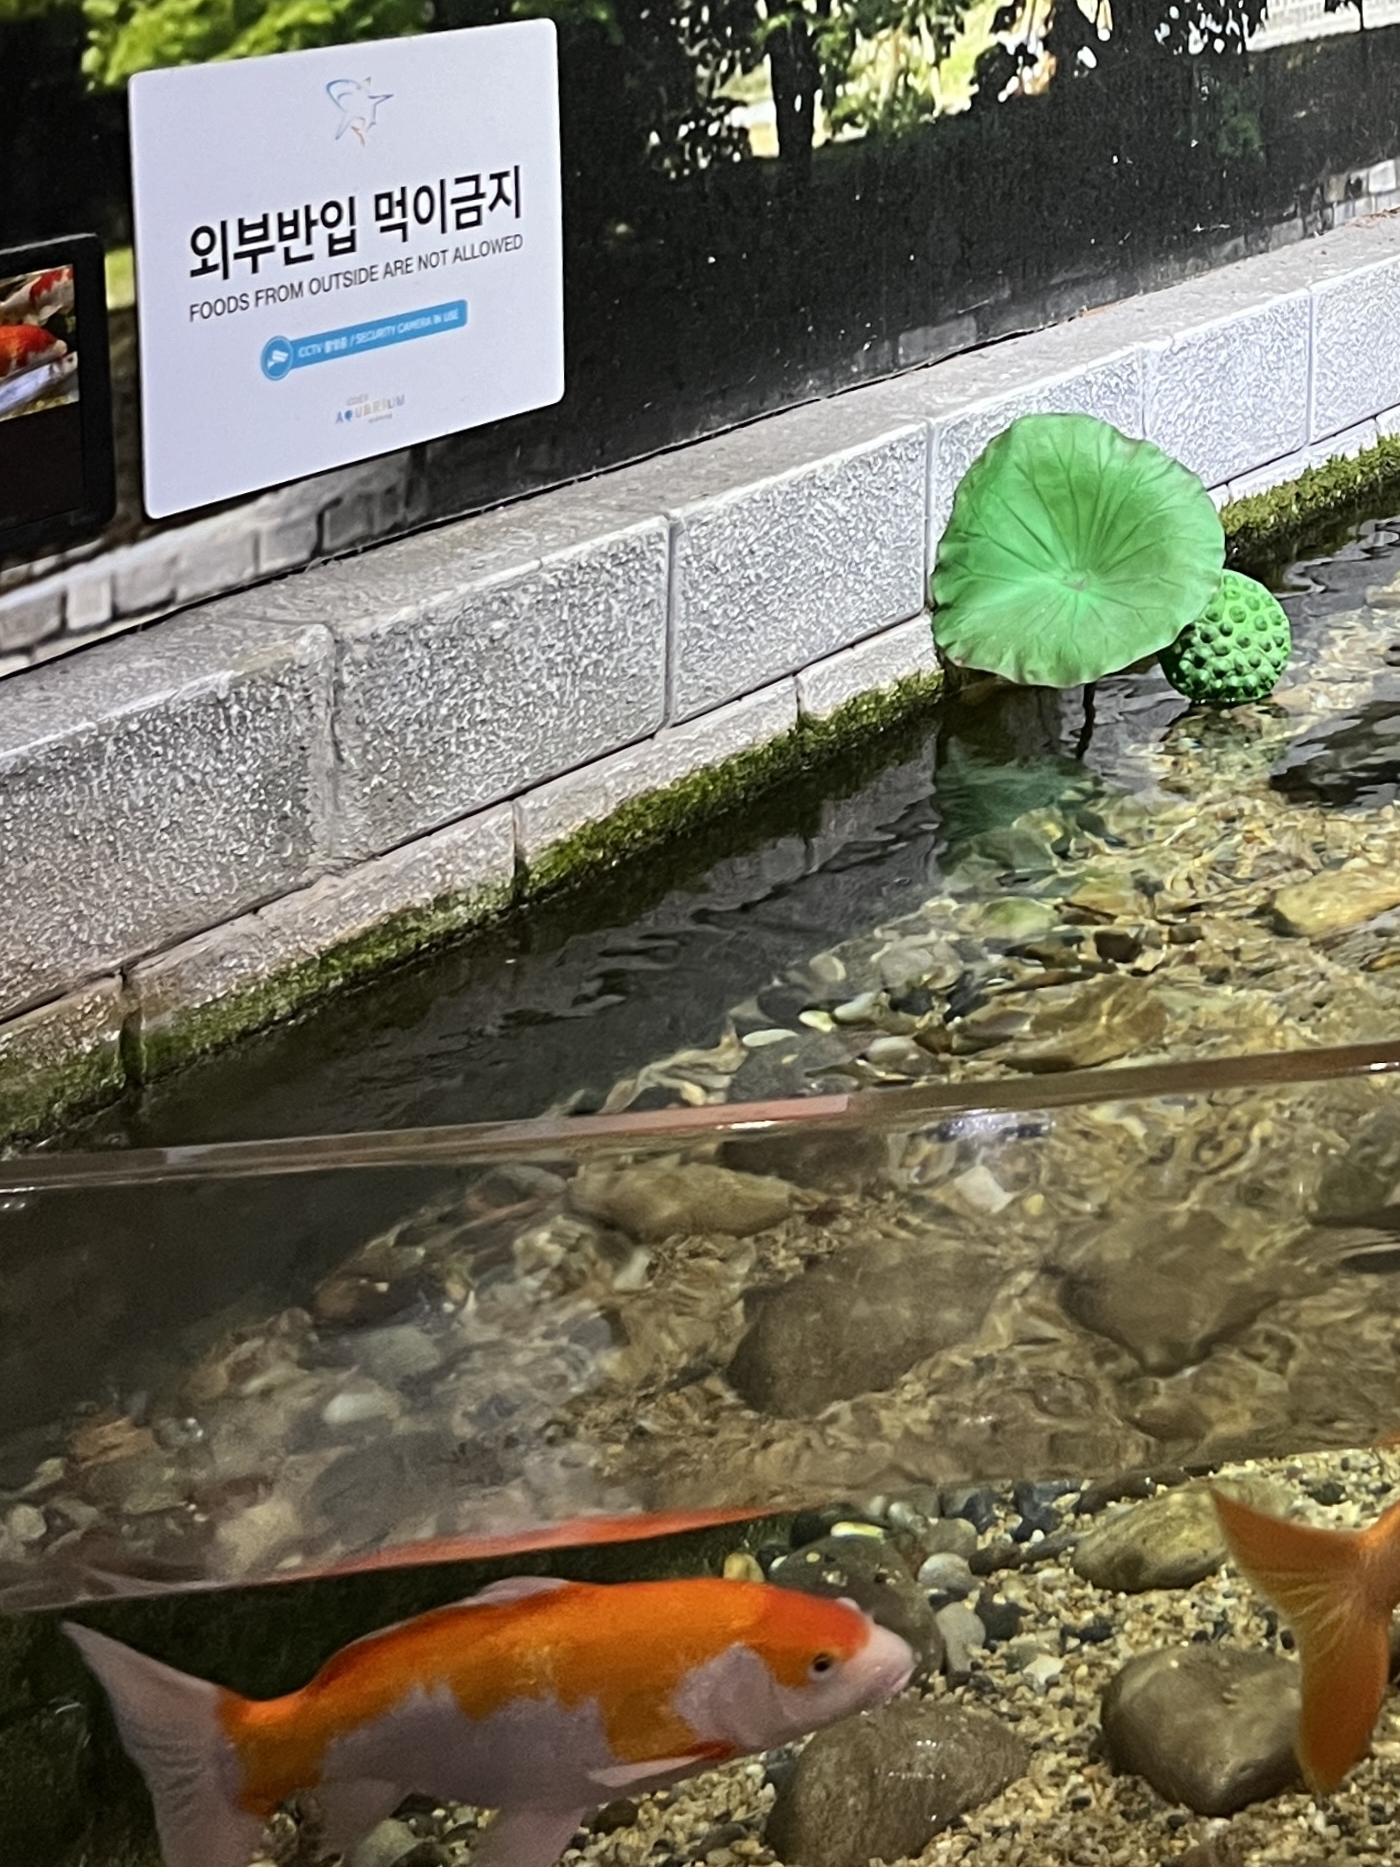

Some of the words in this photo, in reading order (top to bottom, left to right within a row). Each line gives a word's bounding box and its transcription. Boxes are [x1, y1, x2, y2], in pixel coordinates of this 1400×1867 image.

[188, 195, 357, 281] 외부반입
[374, 165, 523, 243] 먹이금지
[189, 293, 250, 323] FOODS
[255, 279, 304, 309] FROM
[310, 264, 379, 296] OUTSIDE
[383, 257, 414, 279] ARE
[418, 250, 448, 271] NOT
[452, 233, 523, 263] ALLOWED
